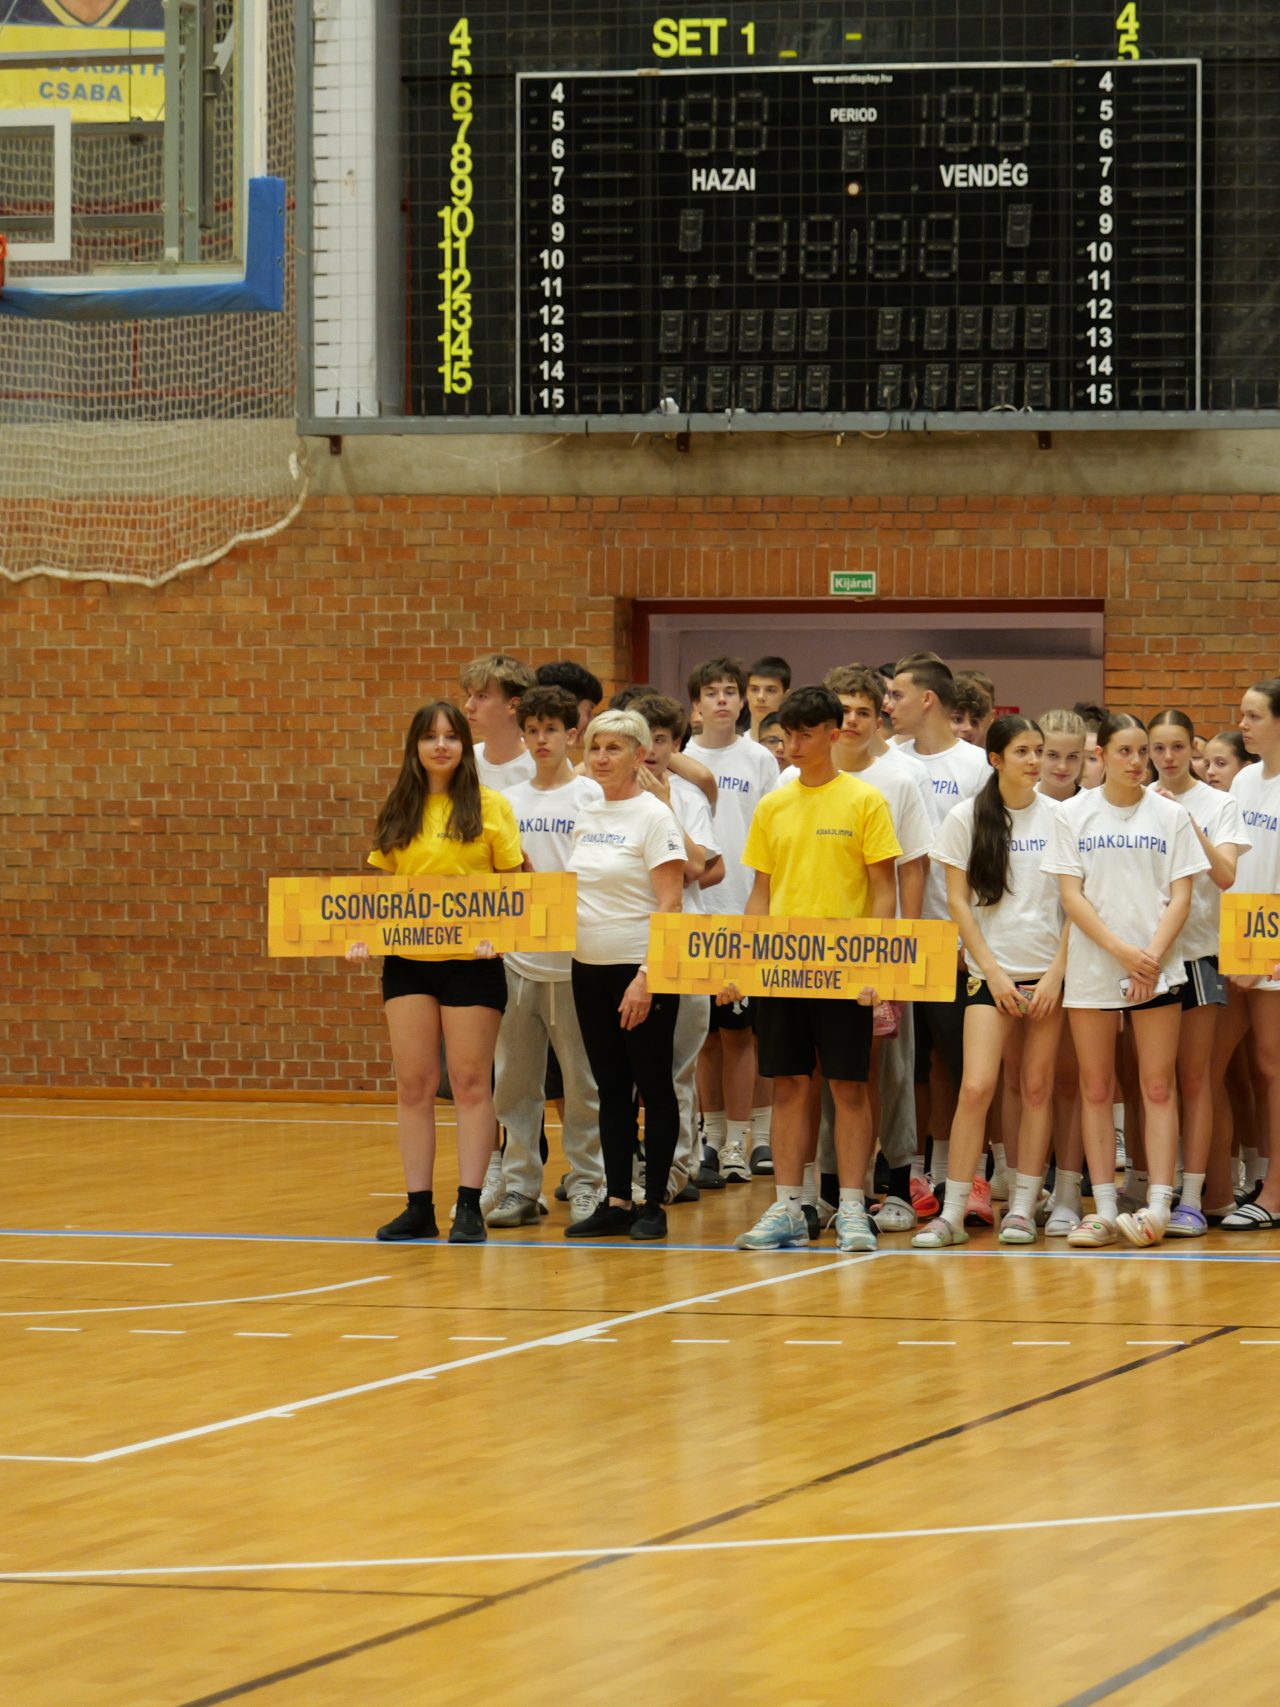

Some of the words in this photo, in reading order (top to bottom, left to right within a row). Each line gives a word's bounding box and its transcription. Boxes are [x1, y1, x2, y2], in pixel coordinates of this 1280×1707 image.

[1116, 2, 1140, 35] 4
[449, 17, 472, 50] 4
[652, 18, 728, 58] SET
[740, 21, 755, 56] 1
[1117, 34, 1140, 60] 5
[451, 49, 473, 76] 5
[39, 81, 122, 102] CSABA
[1099, 71, 1113, 92] 4
[450, 82, 473, 113] 6
[551, 82, 565, 103] 4
[552, 110, 565, 131] 5
[830, 107, 878, 123] PERIOD
[1100, 100, 1113, 121] 5
[452, 112, 473, 143] 7
[551, 138, 565, 159] 6
[1099, 128, 1113, 149] 6
[450, 142, 473, 175] 8
[1099, 157, 1113, 178] 7
[551, 166, 565, 187] 7
[691, 167, 756, 192] HAZAI
[940, 158, 1029, 188] VENDÉG
[450, 174, 473, 207] 9
[1099, 185, 1113, 206] 8
[552, 194, 565, 215] 8
[437, 205, 475, 238] 10
[551, 222, 565, 242] 9
[1099, 213, 1113, 234] 9
[438, 237, 467, 269] 11
[539, 249, 565, 270] 10
[1086, 241, 1113, 262] 10
[438, 268, 472, 300] 12
[541, 277, 562, 297] 11
[1088, 270, 1110, 291] 11
[438, 299, 473, 332] 13
[539, 305, 564, 325] 12
[1086, 298, 1112, 319] 12
[438, 329, 473, 362] 14
[539, 332, 564, 353] 13
[1086, 327, 1112, 348] 13
[539, 360, 565, 381] 14
[1086, 355, 1113, 376] 14
[438, 361, 473, 394] 15
[539, 388, 565, 408] 15
[1086, 384, 1113, 404] 15
[835, 578, 872, 591] Kijárat
[1078, 834, 1167, 855] #DIAKOLIMPIA
[321, 886, 525, 920] CSONGRÁD-CSANÁD
[382, 924, 462, 946] VÁRMEGYE
[688, 927, 917, 964] GYŐR-MOSON-SOPRON
[761, 965, 842, 990] VÁRMEGYE
